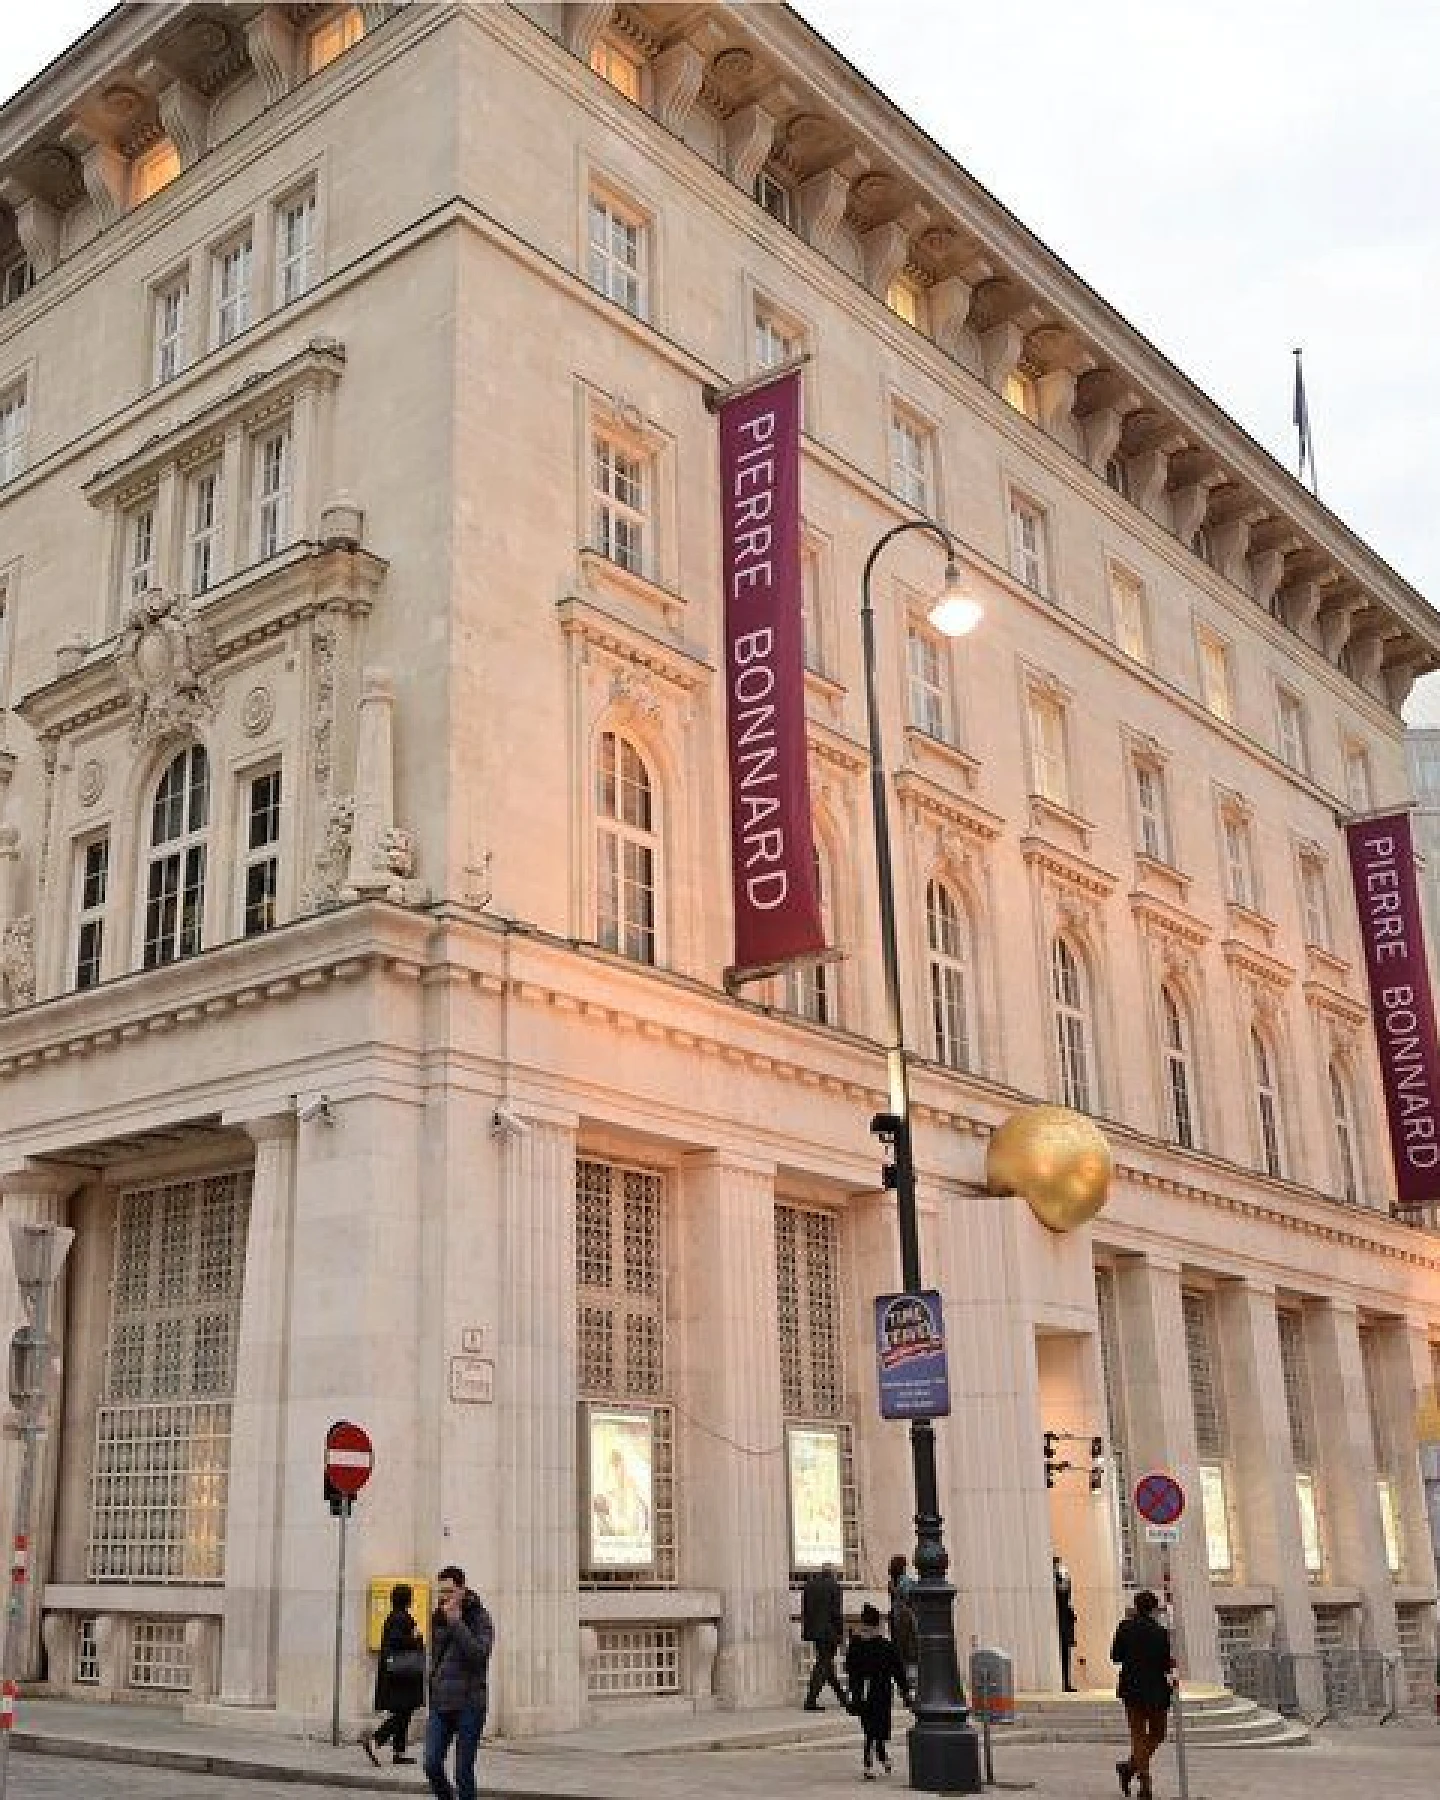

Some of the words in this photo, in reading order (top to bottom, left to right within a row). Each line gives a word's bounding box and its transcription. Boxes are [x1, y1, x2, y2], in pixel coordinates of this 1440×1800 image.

[734, 412, 775, 599] PIERRE
[734, 628, 788, 911] BONNARD
[1364, 836, 1408, 963] PIERRE
[1382, 985, 1438, 1169] BONNARD
